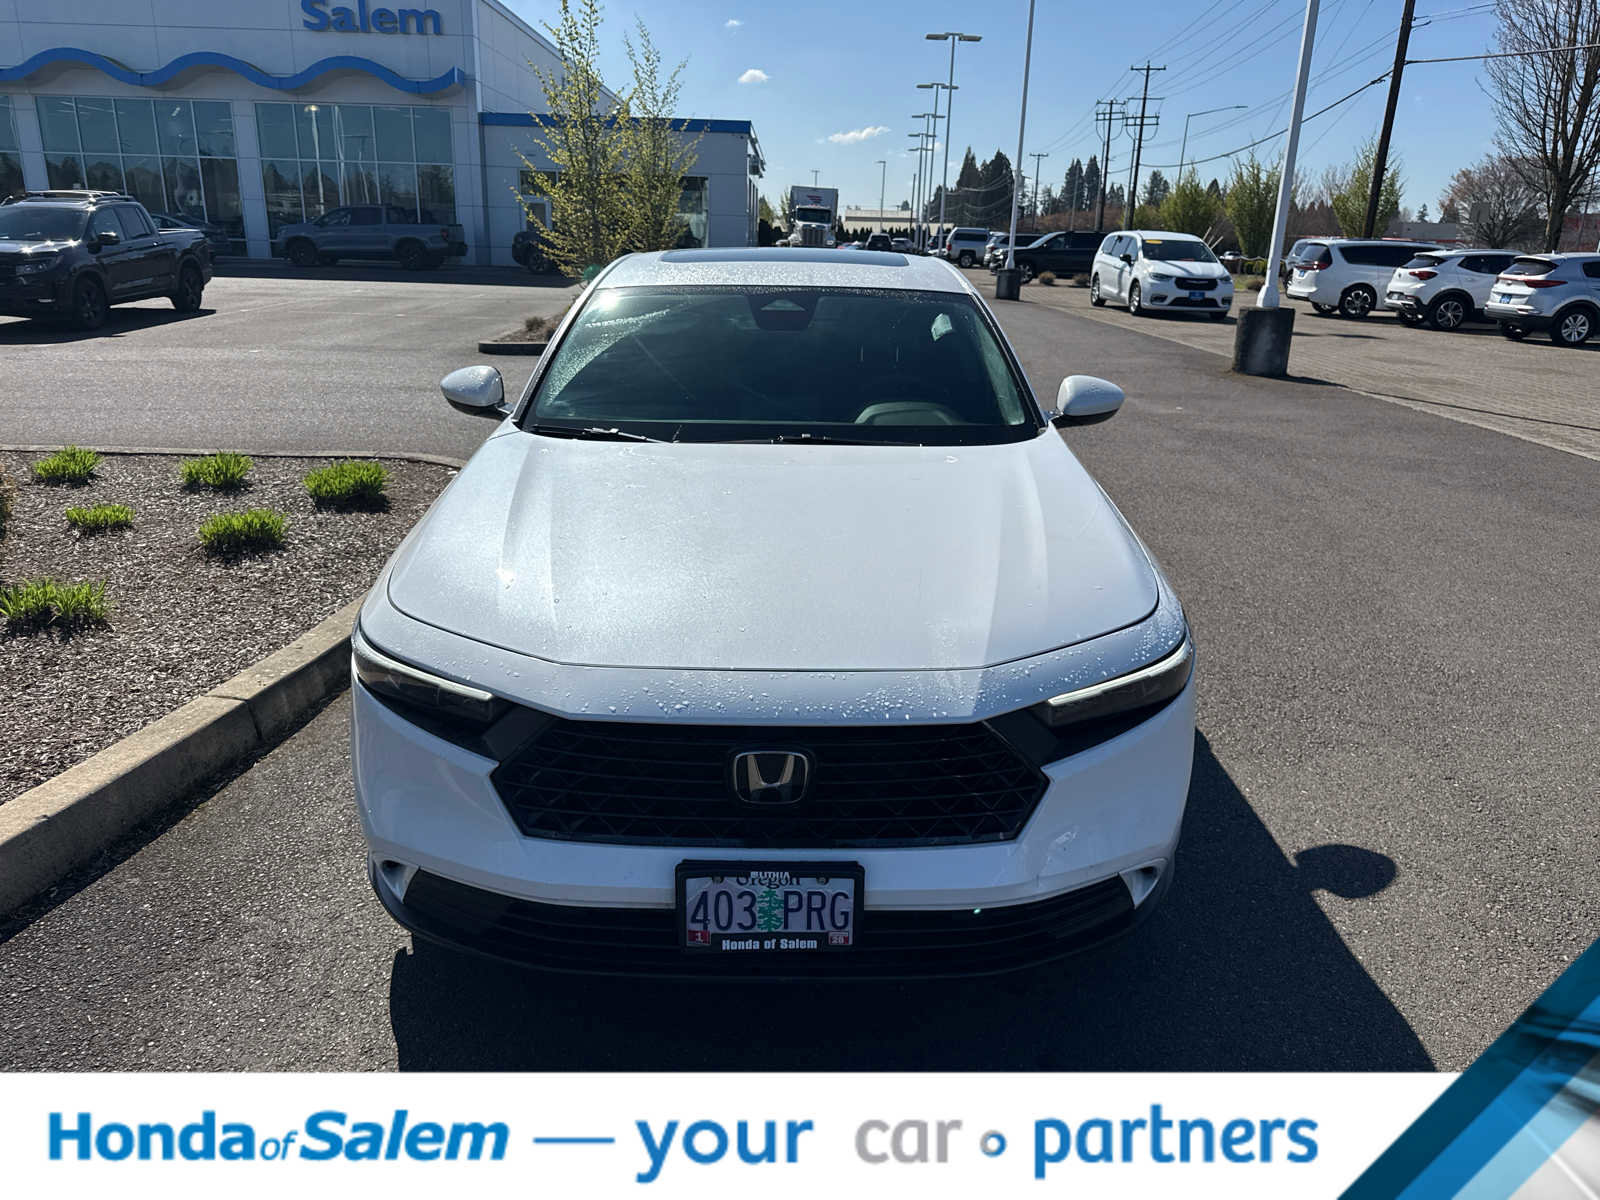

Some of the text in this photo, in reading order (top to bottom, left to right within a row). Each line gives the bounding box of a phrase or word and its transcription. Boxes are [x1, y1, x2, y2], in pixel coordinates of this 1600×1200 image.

[301, 0, 442, 35] Salem
[690, 890, 849, 931] 403 PRG
[722, 938, 818, 950] Honda of Salem
